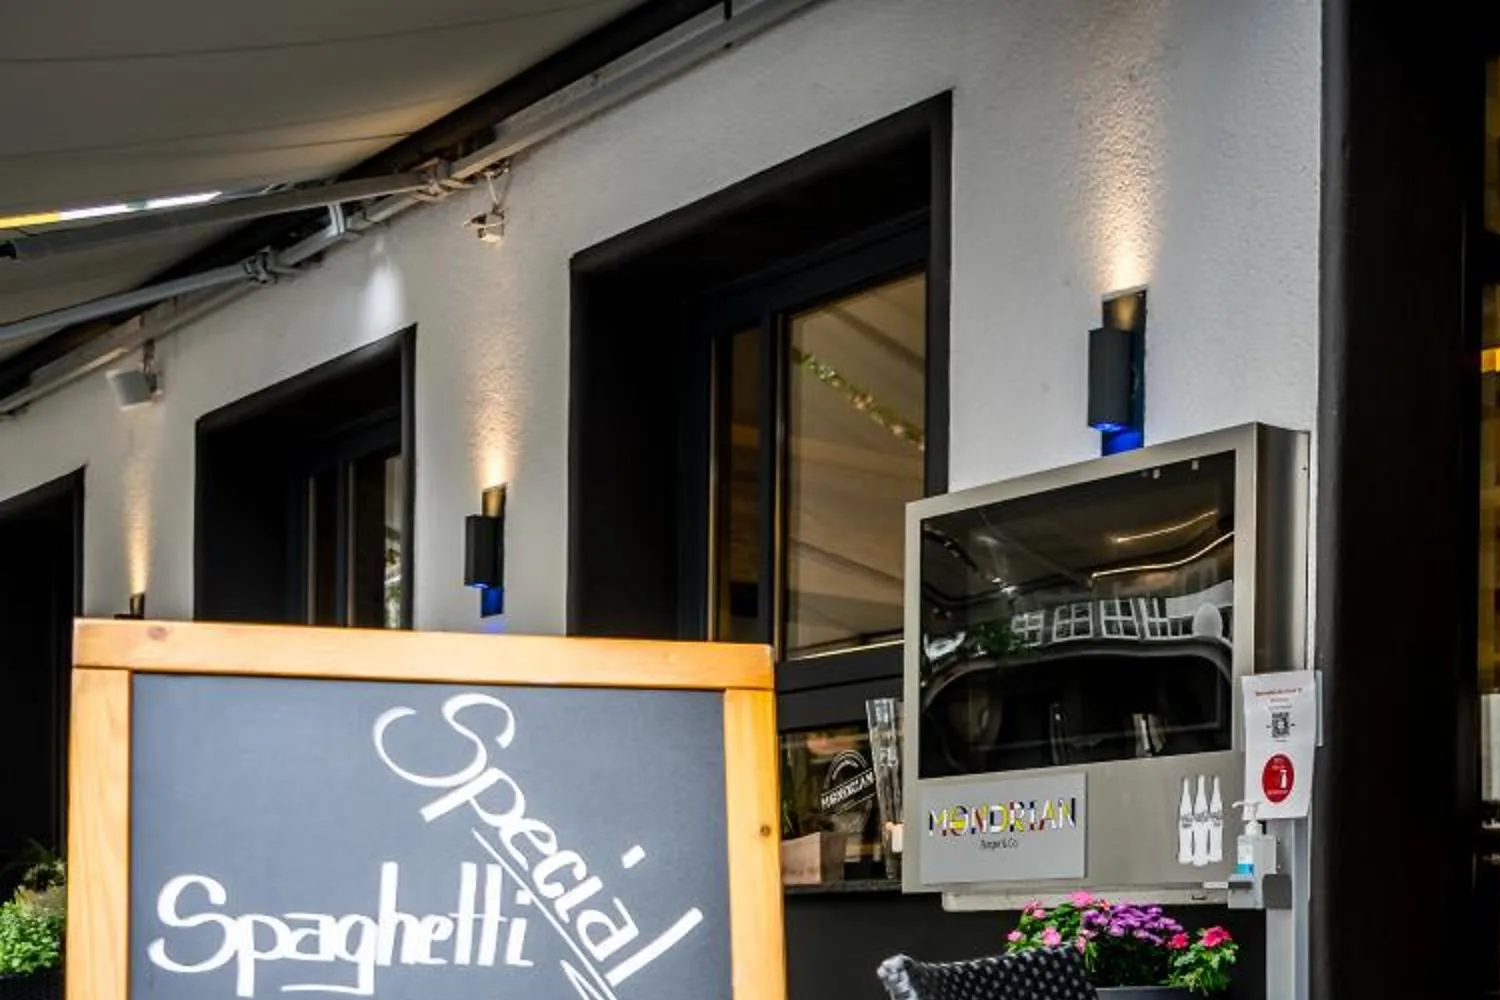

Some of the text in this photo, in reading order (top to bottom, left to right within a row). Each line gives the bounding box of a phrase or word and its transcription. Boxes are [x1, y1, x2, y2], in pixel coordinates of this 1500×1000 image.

[372, 692, 704, 987] Special
[928, 798, 1077, 837] MONDRIAN
[147, 861, 534, 998] Spaghetti
